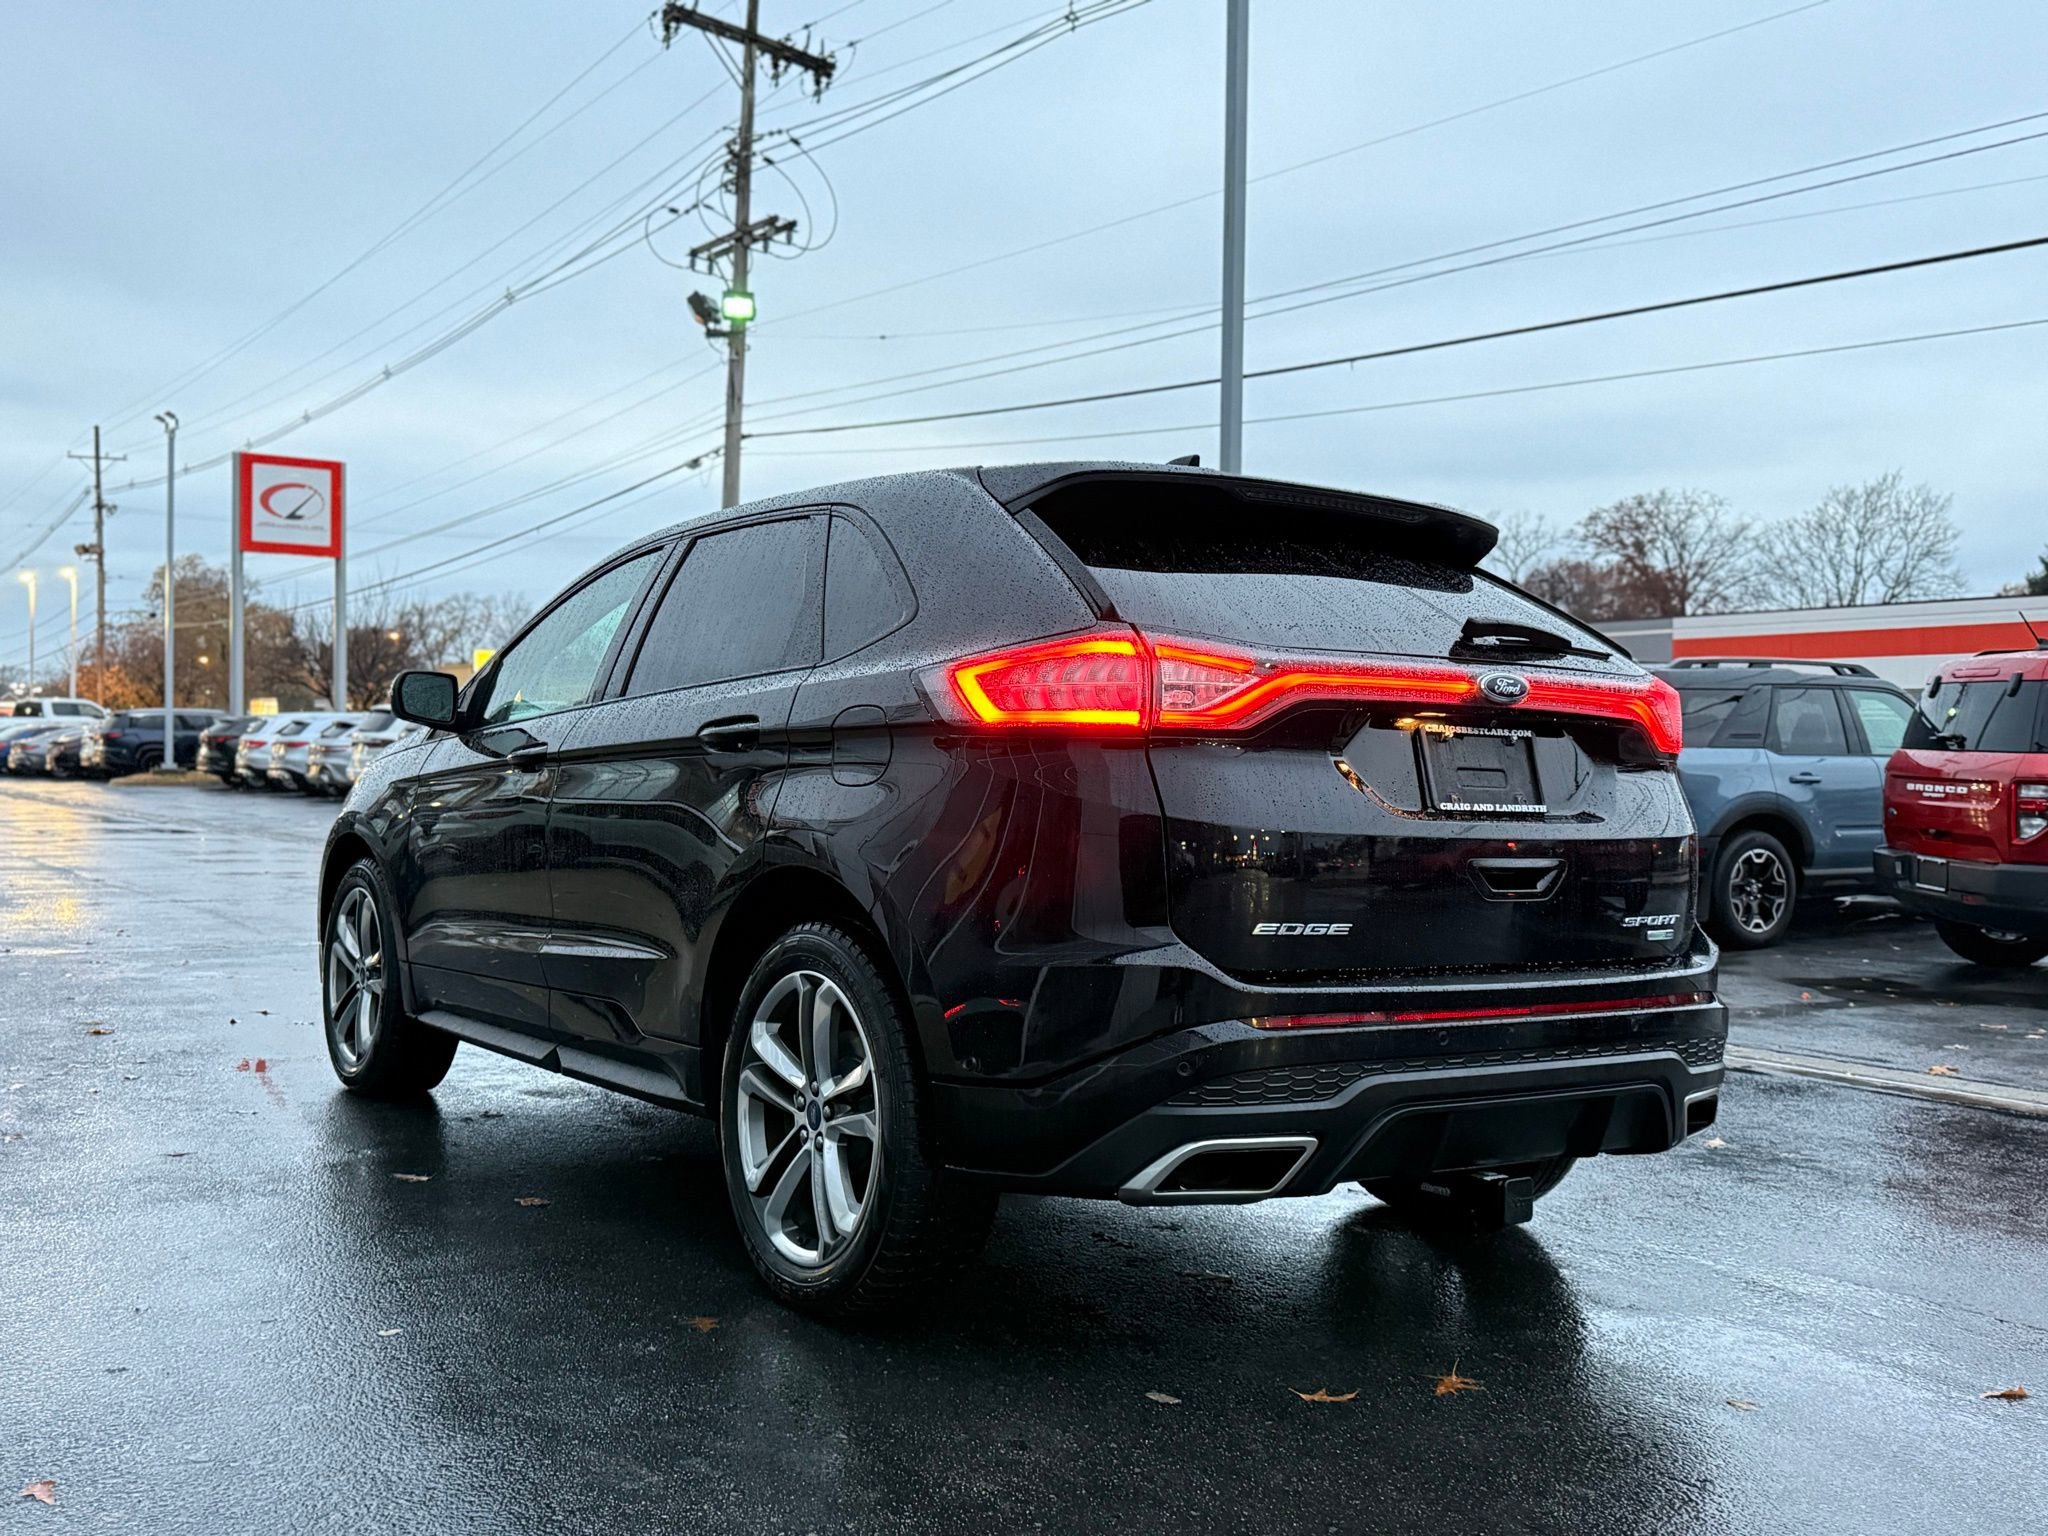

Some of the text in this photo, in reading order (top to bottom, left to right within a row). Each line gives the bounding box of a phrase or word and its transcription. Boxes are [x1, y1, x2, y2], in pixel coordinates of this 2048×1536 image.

[1494, 678, 1521, 695] Ford
[1906, 782, 1969, 794] BRONCO
[1440, 802, 1548, 812] CRAIG AND LANDRETH
[1621, 914, 1681, 927] SPORT
[1251, 922, 1354, 936] EDGE
